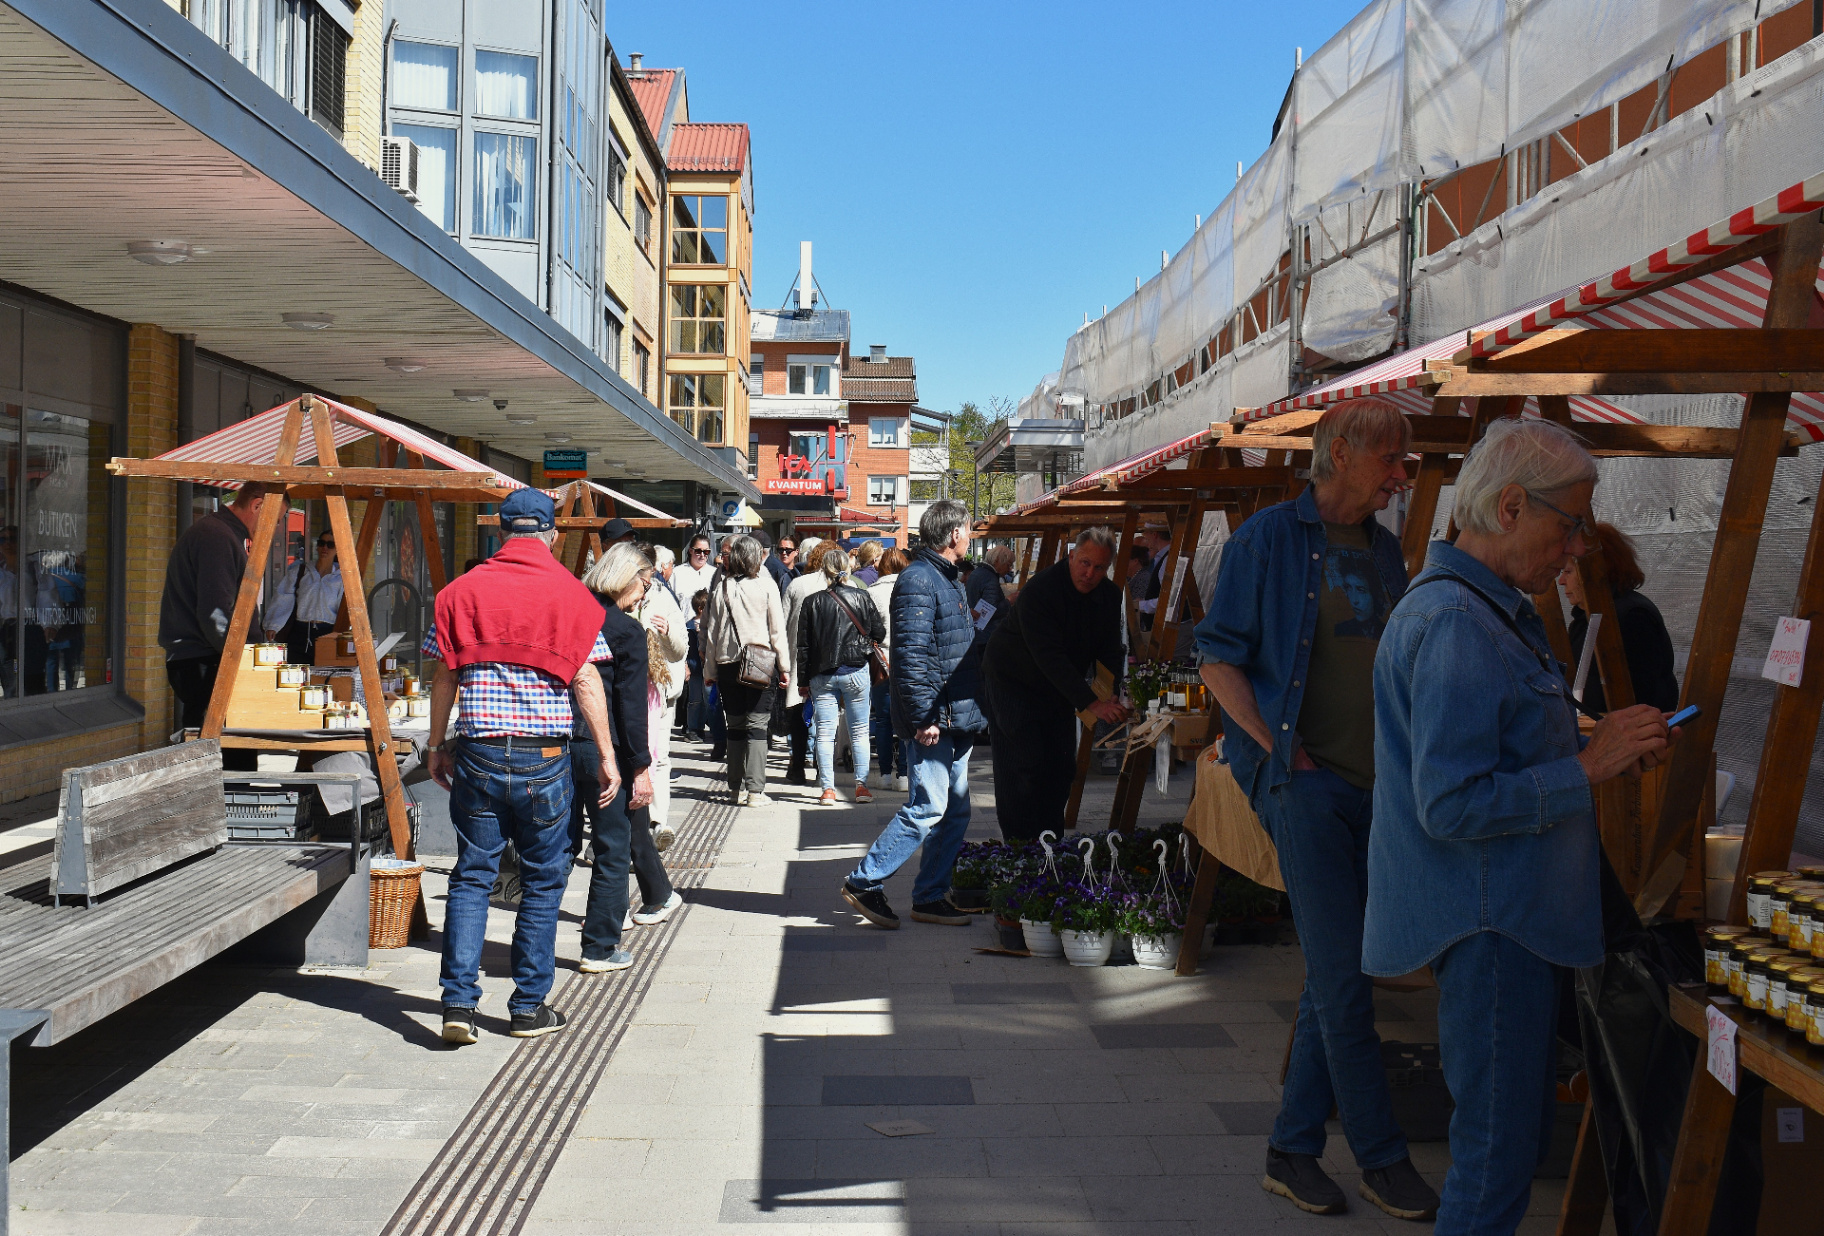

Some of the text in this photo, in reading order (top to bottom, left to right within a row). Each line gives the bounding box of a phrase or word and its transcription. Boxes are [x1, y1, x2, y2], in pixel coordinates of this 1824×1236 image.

[45, 443, 73, 475] MAX
[546, 452, 583, 461] Bankomat
[778, 453, 813, 473] ICA
[767, 480, 823, 491] KVANTUM
[38, 509, 78, 538] BUTIKEN
